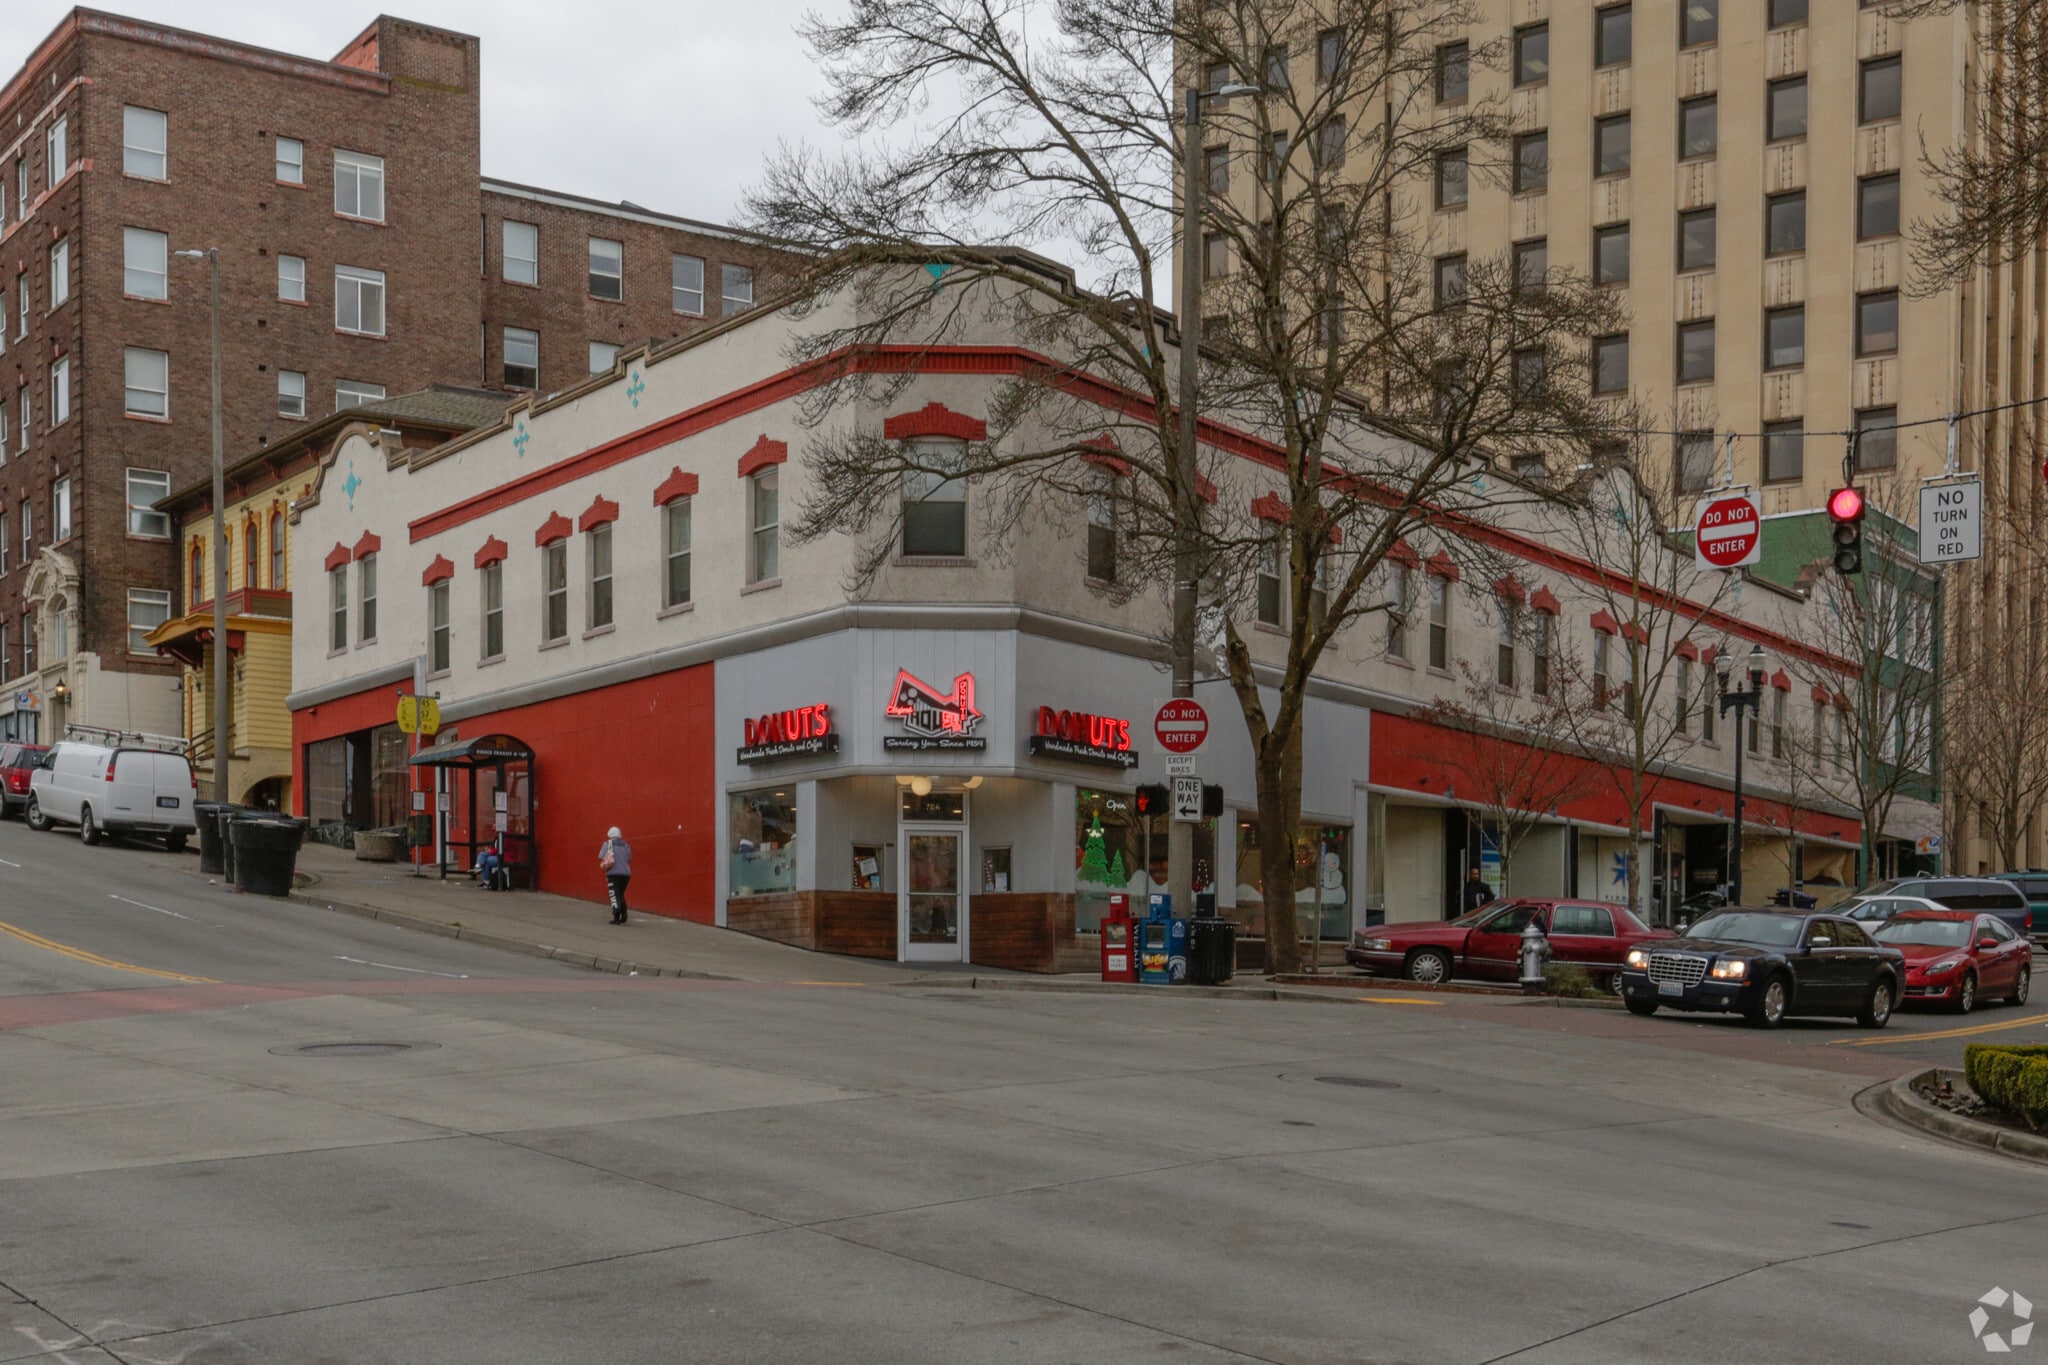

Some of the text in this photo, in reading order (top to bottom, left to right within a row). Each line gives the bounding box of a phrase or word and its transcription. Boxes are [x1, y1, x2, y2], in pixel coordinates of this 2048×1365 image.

[1938, 490, 1964, 506] NO
[1706, 507, 1750, 525] DO NOT
[1933, 509, 1967, 523] TURN
[1940, 527, 1958, 539] ON
[1710, 539, 1746, 555] ENTER
[1938, 542, 1964, 556] RED
[905, 709, 959, 731] HOUSE
[1162, 709, 1201, 719] DO NOT
[744, 702, 830, 749] DONUTS
[1039, 705, 1131, 751] DONUTS
[887, 739, 984, 749] Serving You Since 1959
[1166, 734, 1197, 743] ENTER
[740, 739, 822, 760] Handmade Fresh Donuts and Coffee
[1045, 741, 1135, 766] Handmade Fresh Donuts and Coffee
[1177, 781, 1199, 792] ONE
[1107, 800, 1126, 811] Open
[1177, 793, 1199, 804] WAY
